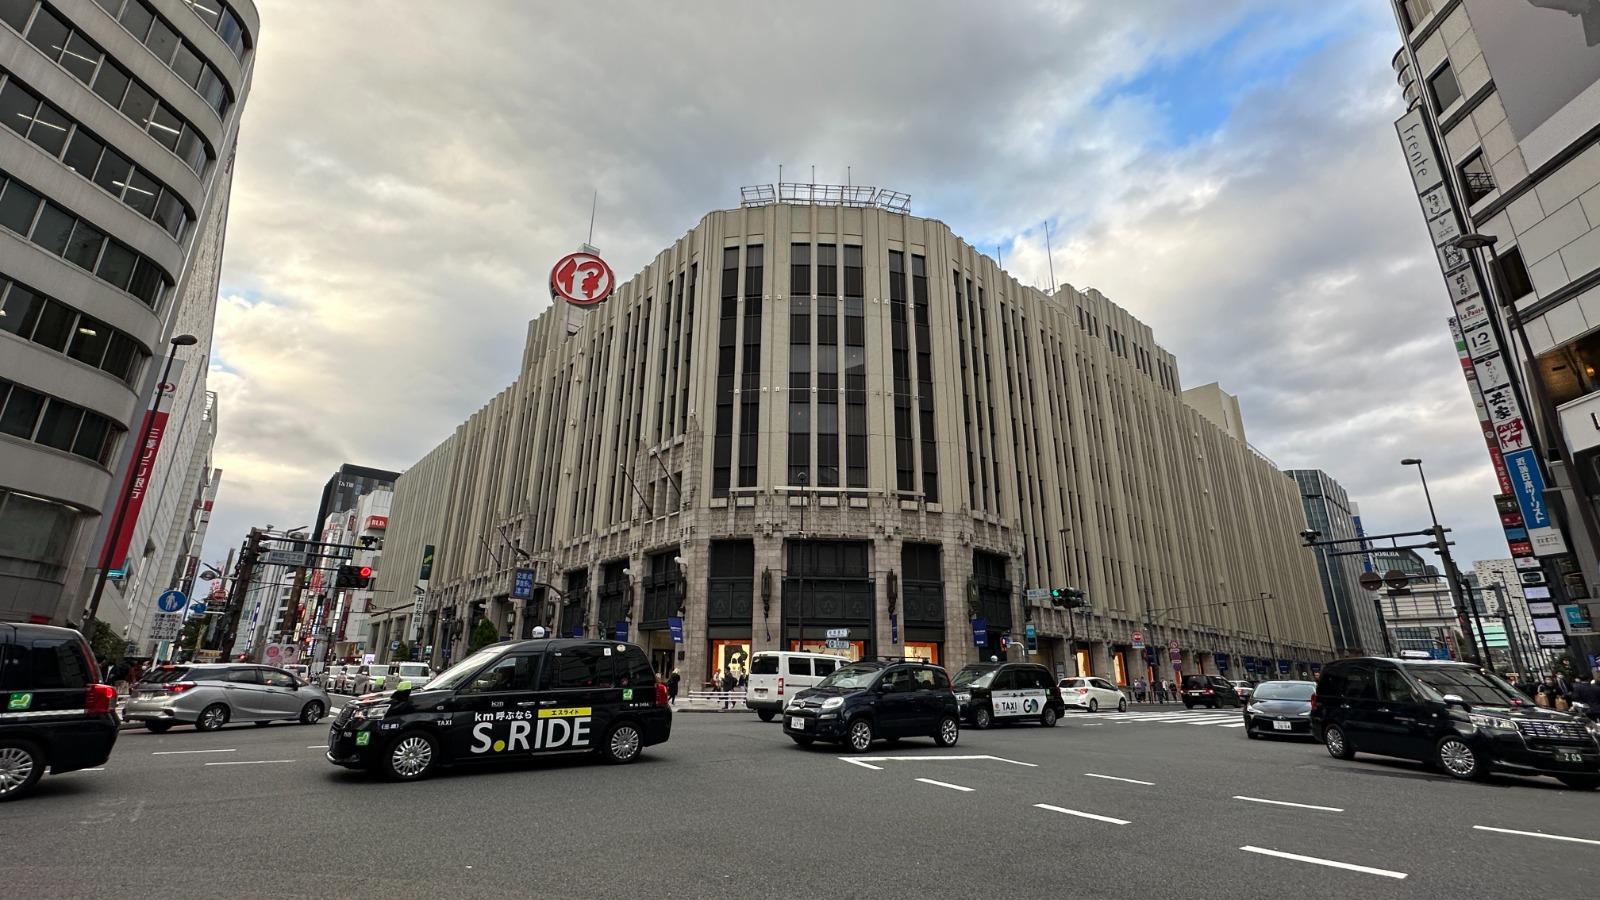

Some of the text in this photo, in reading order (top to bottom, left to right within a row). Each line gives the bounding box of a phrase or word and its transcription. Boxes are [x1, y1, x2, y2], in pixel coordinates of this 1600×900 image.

[1403, 121, 1428, 177] frente
[1001, 698, 1039, 714] TAXI GO
[470, 716, 592, 754] S.RIDE
